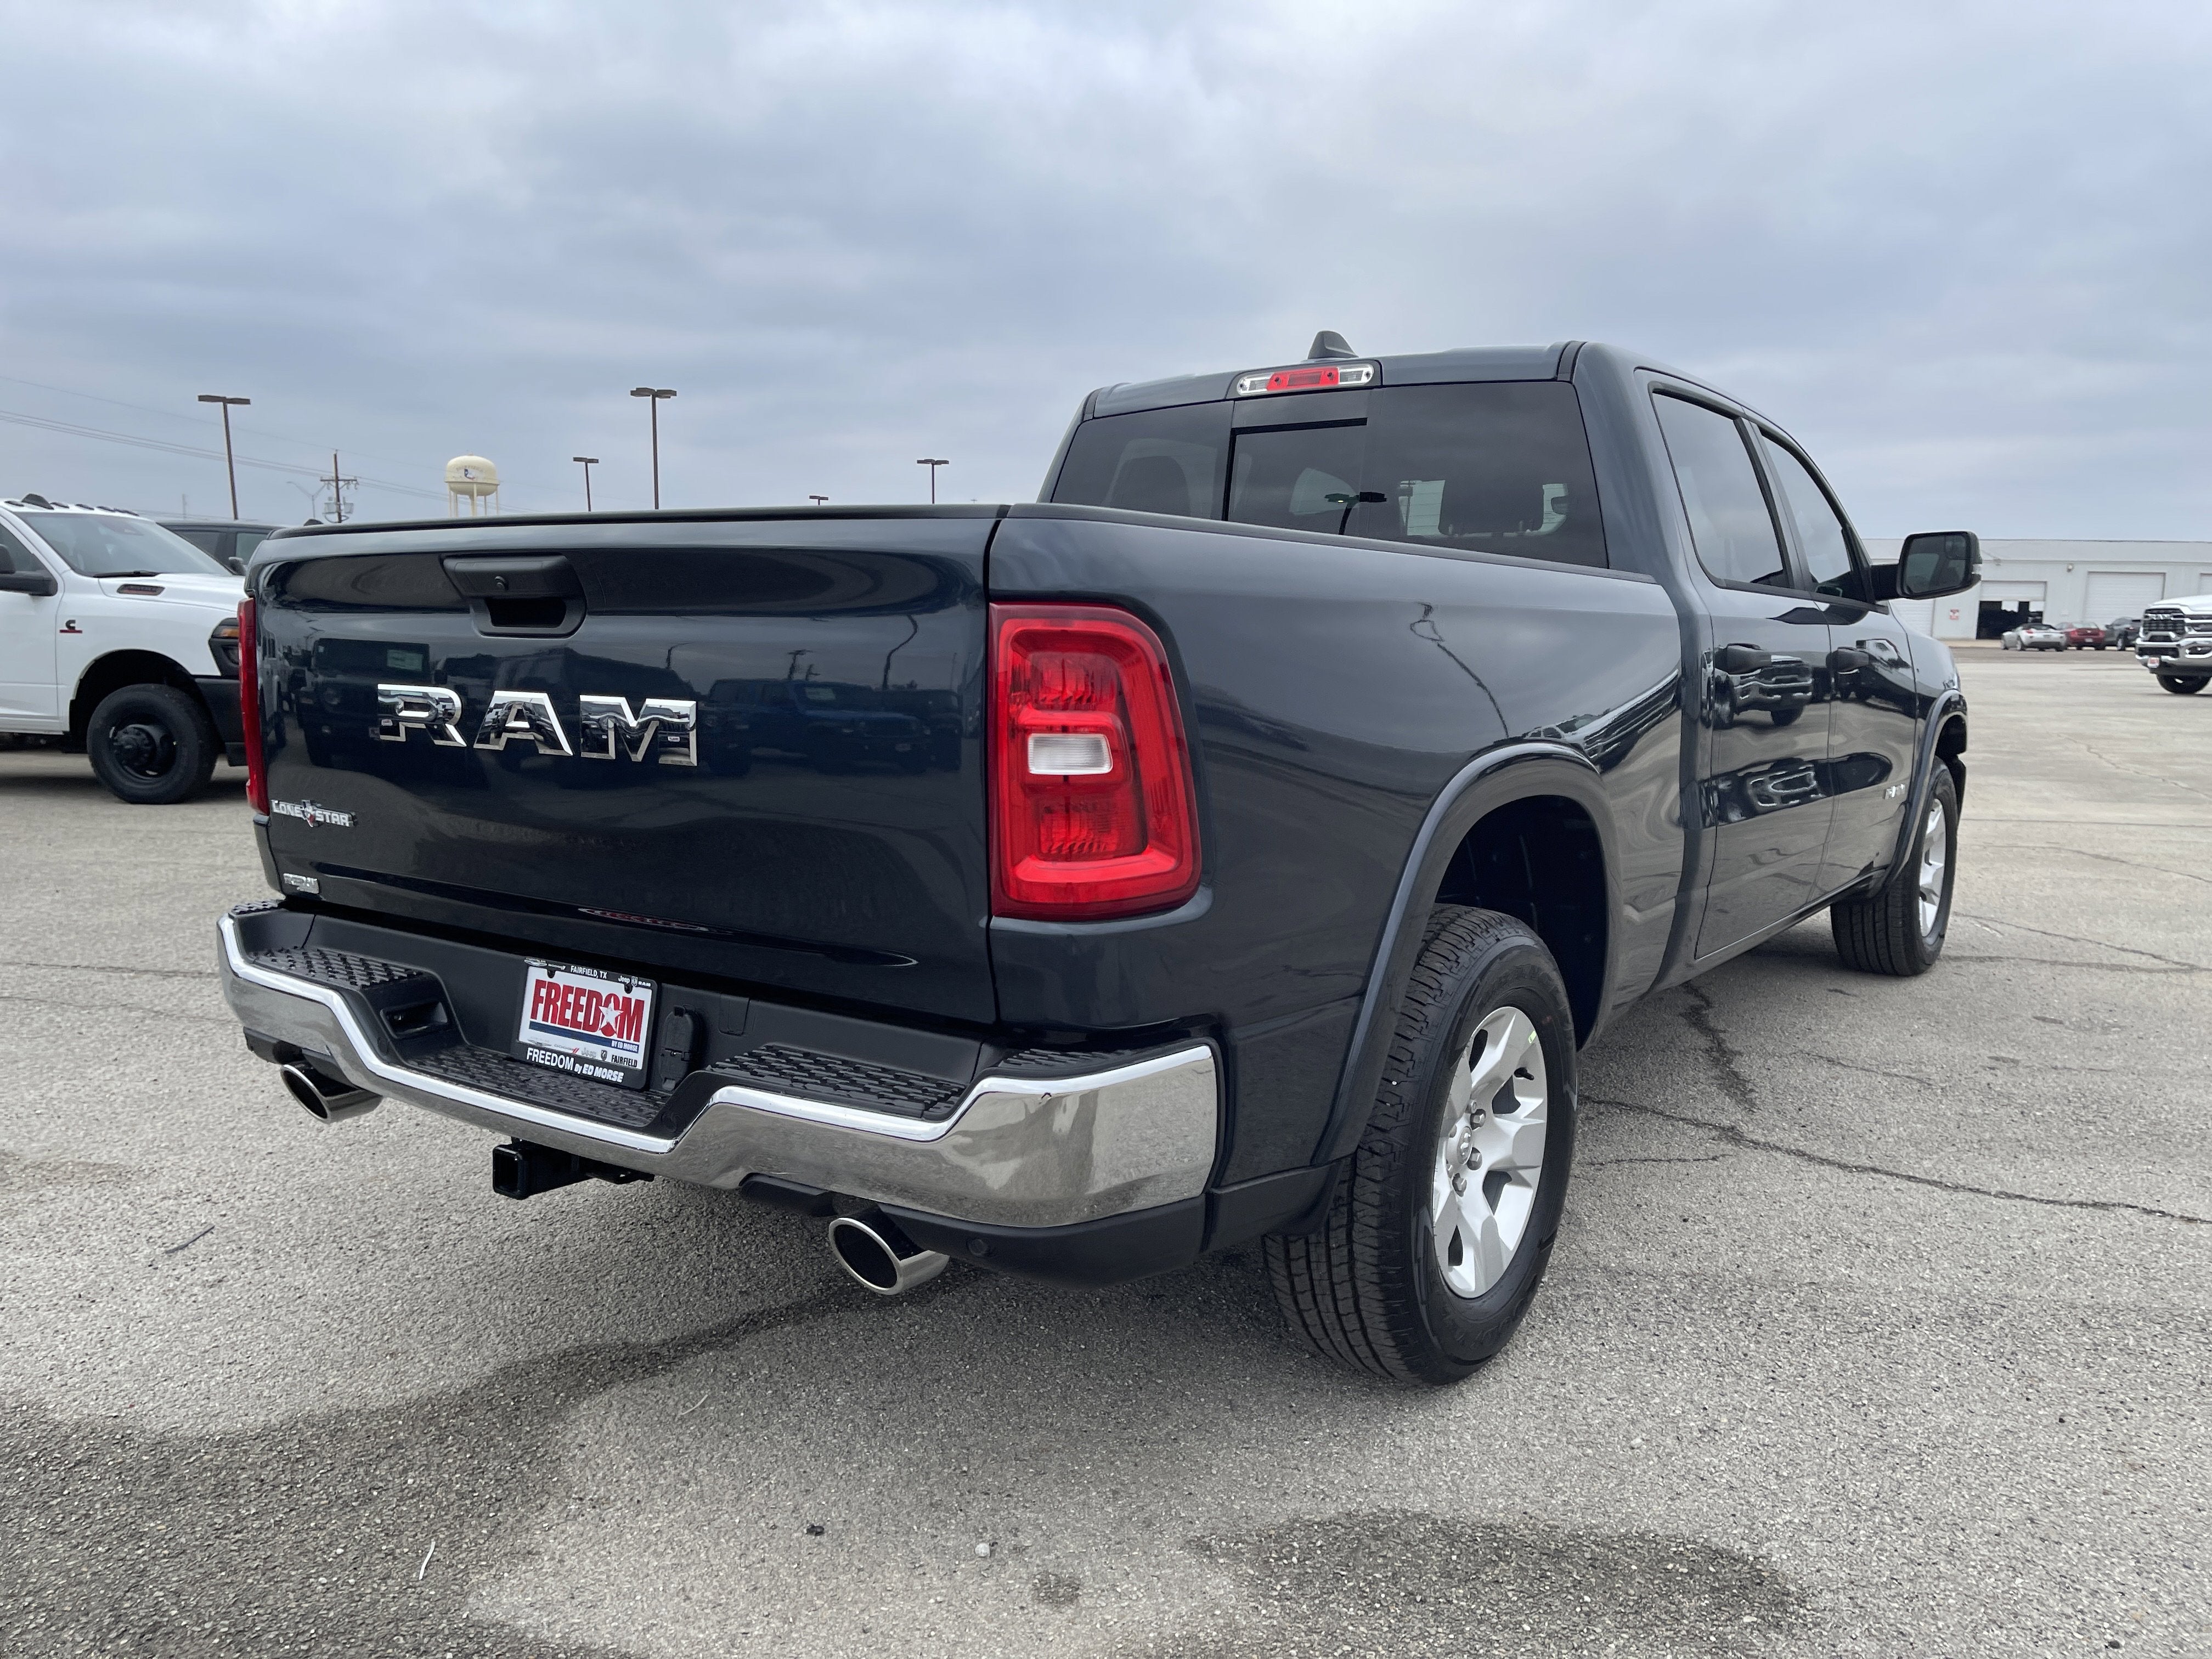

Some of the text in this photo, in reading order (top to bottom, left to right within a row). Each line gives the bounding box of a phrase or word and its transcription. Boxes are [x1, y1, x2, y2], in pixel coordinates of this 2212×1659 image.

[378, 684, 697, 766] RAM
[272, 799, 351, 827] LONE STAR
[571, 965, 599, 979] FAIRFIELD,
[599, 970, 607, 979] TX
[618, 975, 630, 984] Jeep
[530, 979, 645, 1042] FREEDOM
[527, 1047, 574, 1071] FREEDOM
[582, 1063, 594, 1075] ED
[593, 1066, 624, 1083] MORSE
[611, 1054, 637, 1068] FAIRFIELD
